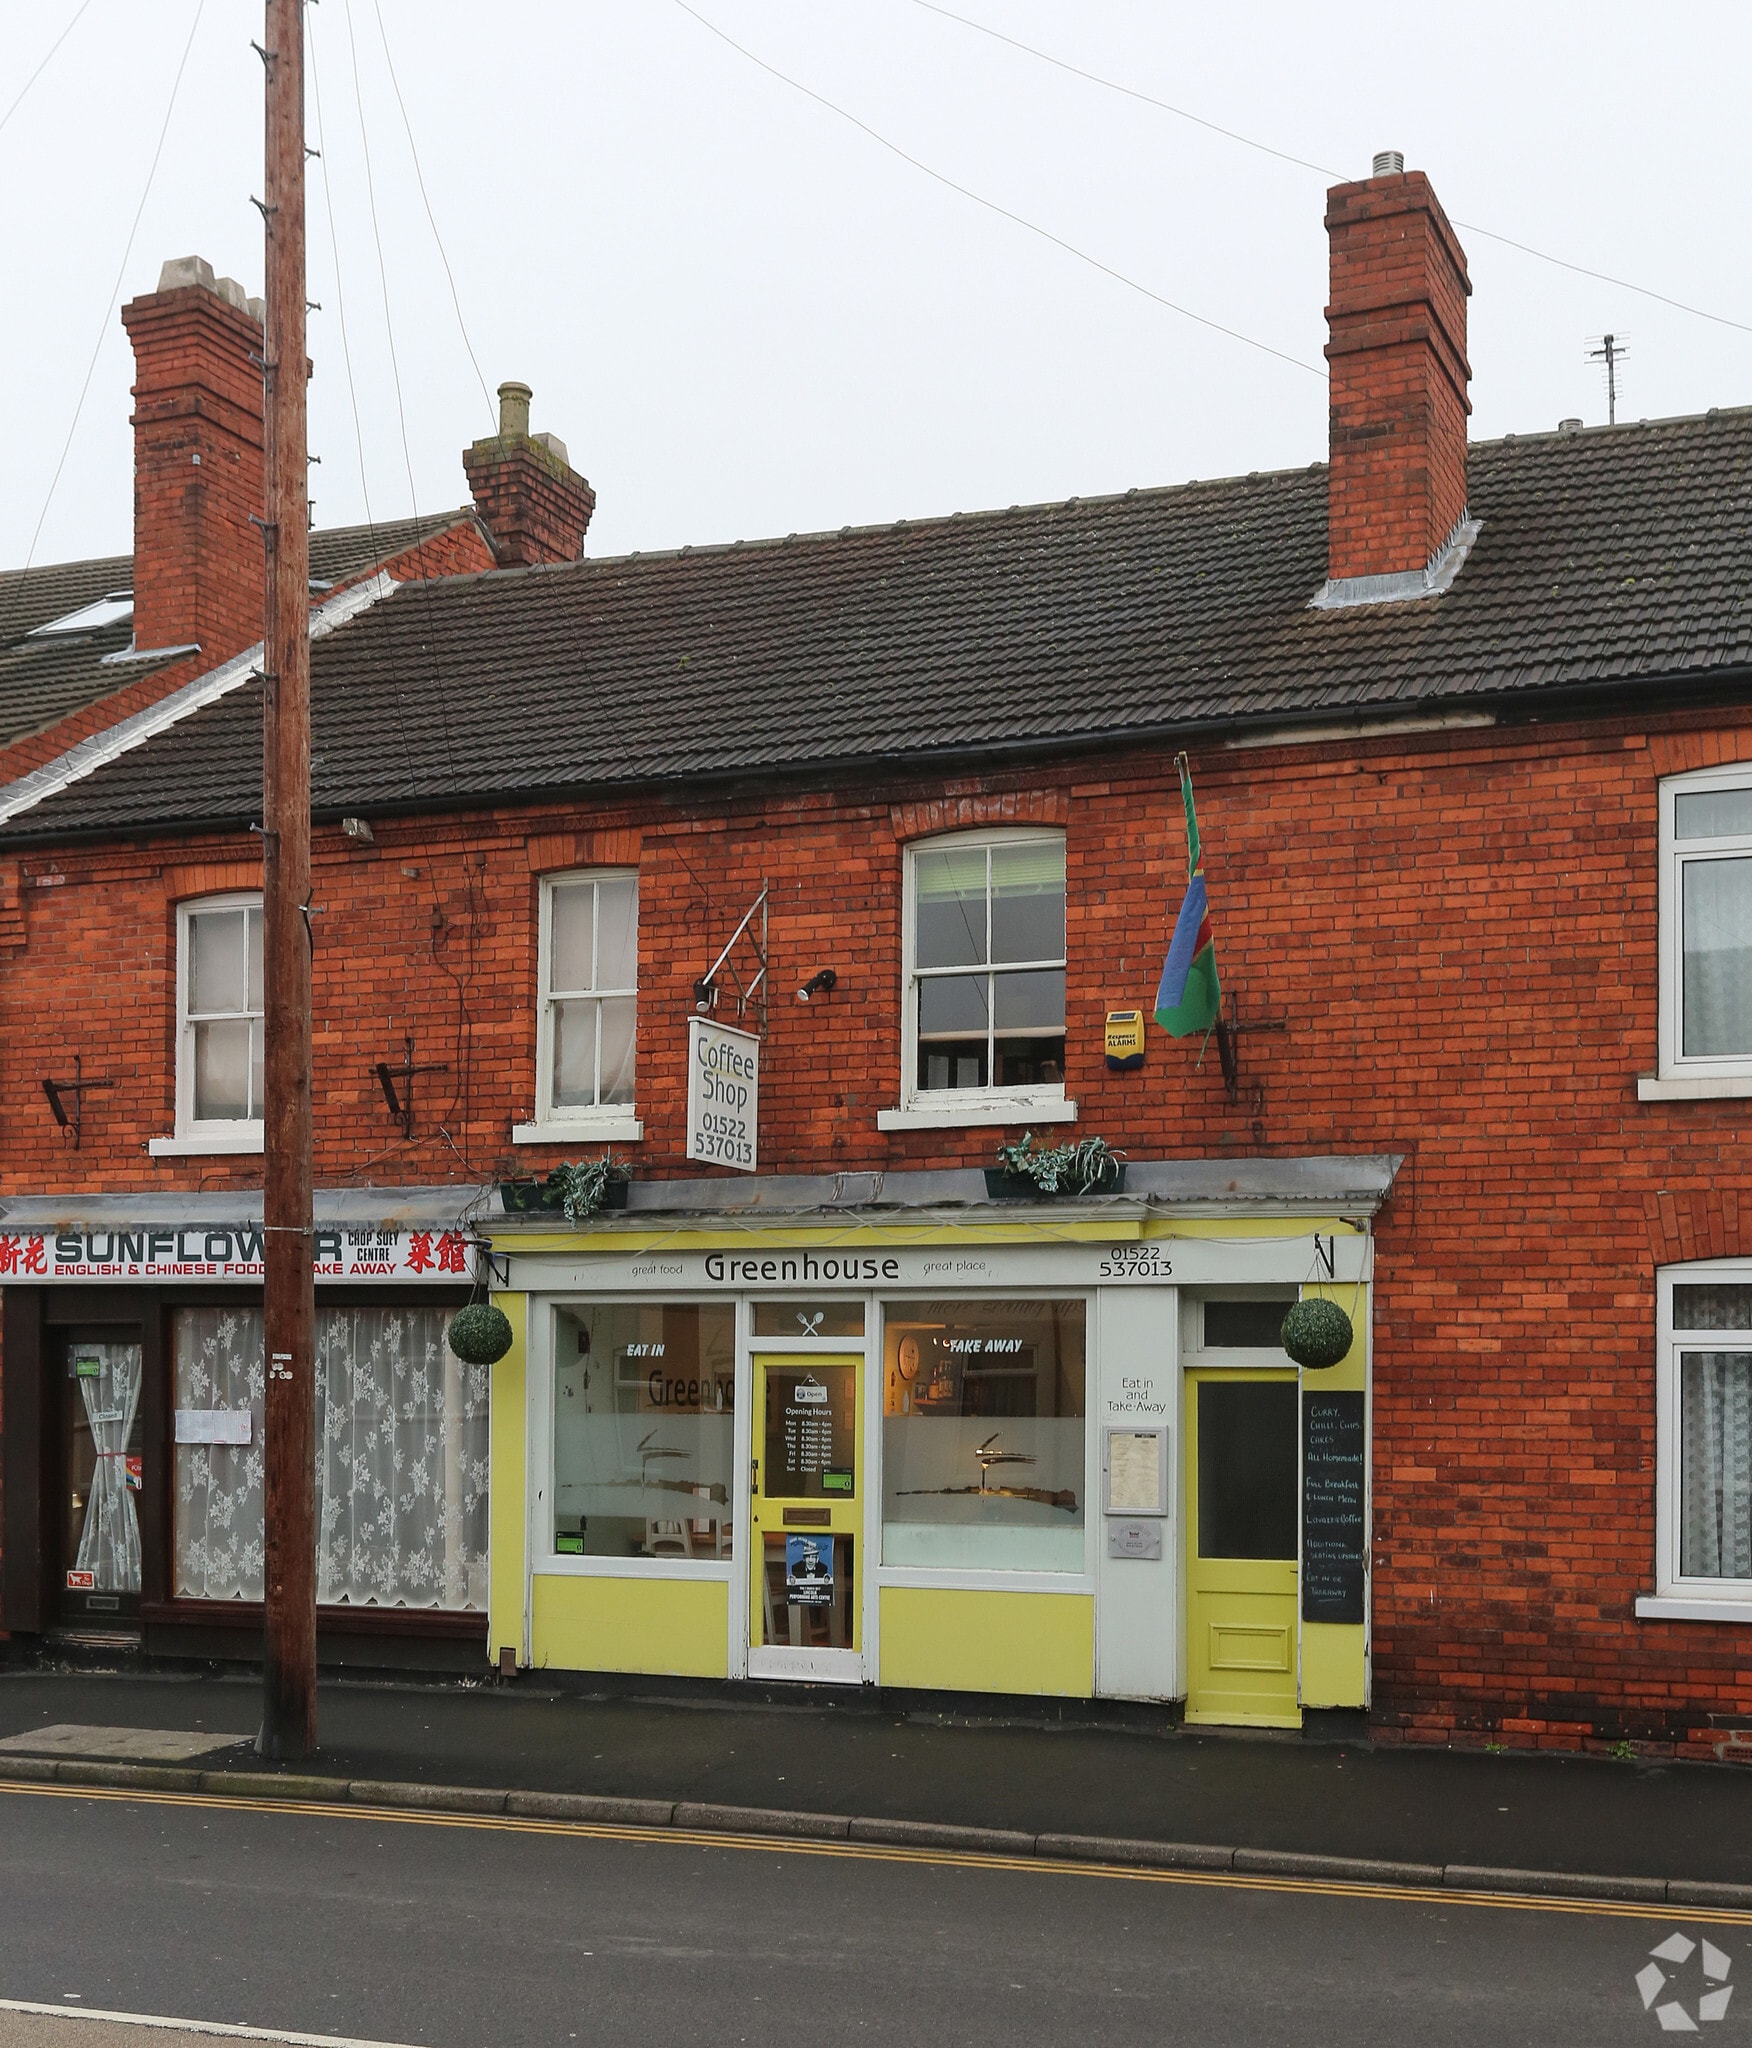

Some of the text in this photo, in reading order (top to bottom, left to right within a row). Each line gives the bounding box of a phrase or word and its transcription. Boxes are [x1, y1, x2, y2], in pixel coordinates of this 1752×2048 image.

[1107, 1039, 1136, 1047] ALARMS
[697, 1037, 754, 1080] Coffee
[702, 1070, 748, 1113] Shop
[702, 1111, 746, 1140] 01522
[695, 1132, 752, 1164] 537013
[348, 1231, 399, 1246] CHOP SUEY
[54, 1232, 343, 1262] SUNFLOWR
[357, 1247, 390, 1261] CENTRE
[1111, 1247, 1160, 1260] 01522
[55, 1264, 122, 1275] ENGLISH
[128, 1264, 140, 1275] &
[145, 1263, 217, 1275] CHINESE
[313, 1263, 343, 1275] AKE
[349, 1263, 397, 1275] AWAY
[631, 1263, 683, 1276] great food
[704, 1253, 900, 1281] Greenhouse
[923, 1260, 986, 1276] great place
[1099, 1261, 1173, 1277] 537013
[627, 1344, 666, 1357] EAT IN
[950, 1339, 1023, 1353] TAKE AWAY
[1122, 1377, 1154, 1389] Eat in
[806, 1389, 823, 1398] Open
[1125, 1389, 1149, 1400] and
[785, 1407, 832, 1417] Opening Hours
